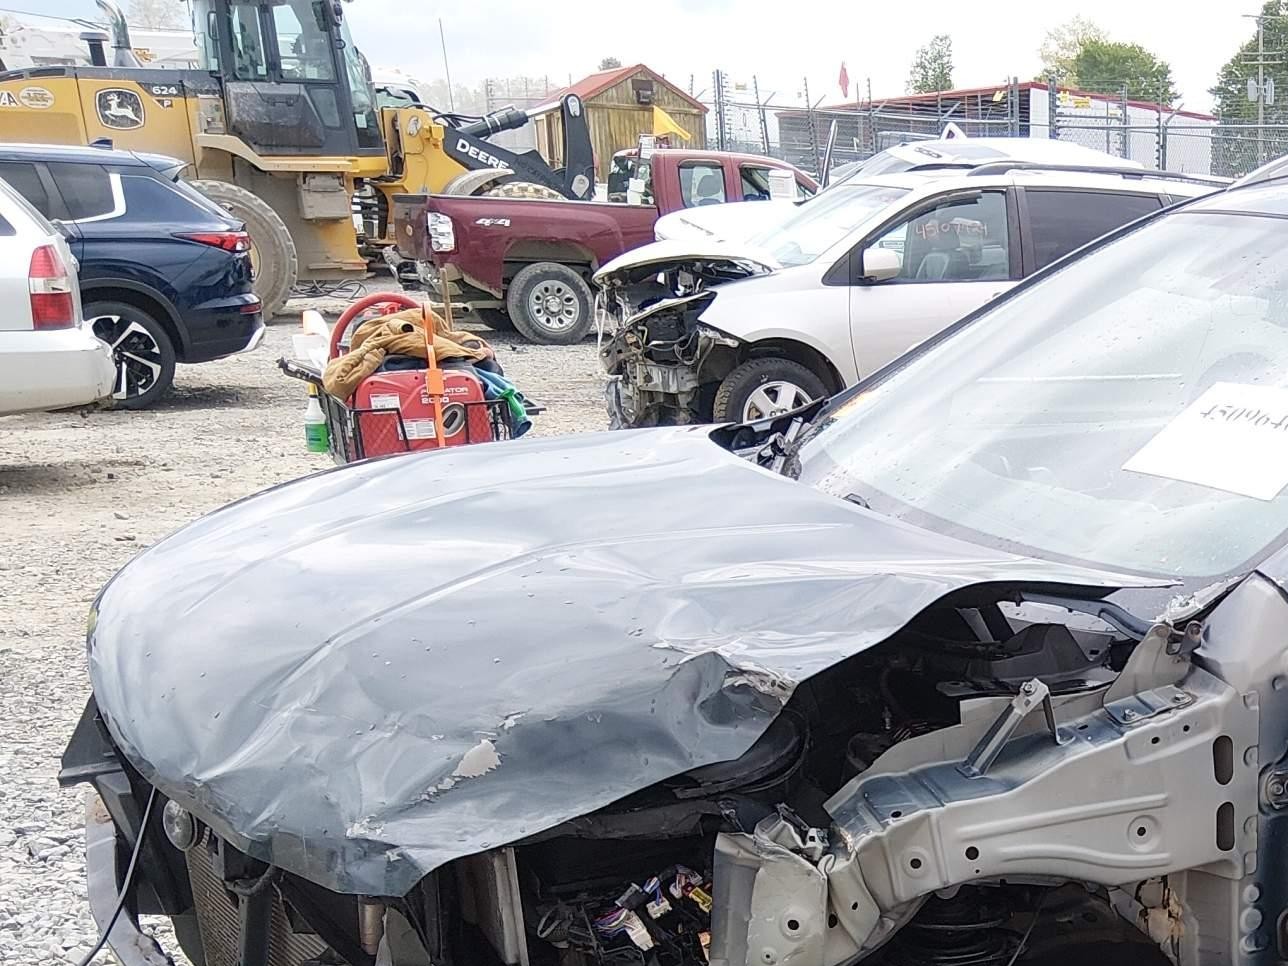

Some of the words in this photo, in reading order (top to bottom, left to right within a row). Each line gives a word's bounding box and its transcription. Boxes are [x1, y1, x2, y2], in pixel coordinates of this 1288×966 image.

[152, 86, 177, 95] 624
[456, 138, 510, 169] DEERE
[421, 387, 468, 396] PATOR
